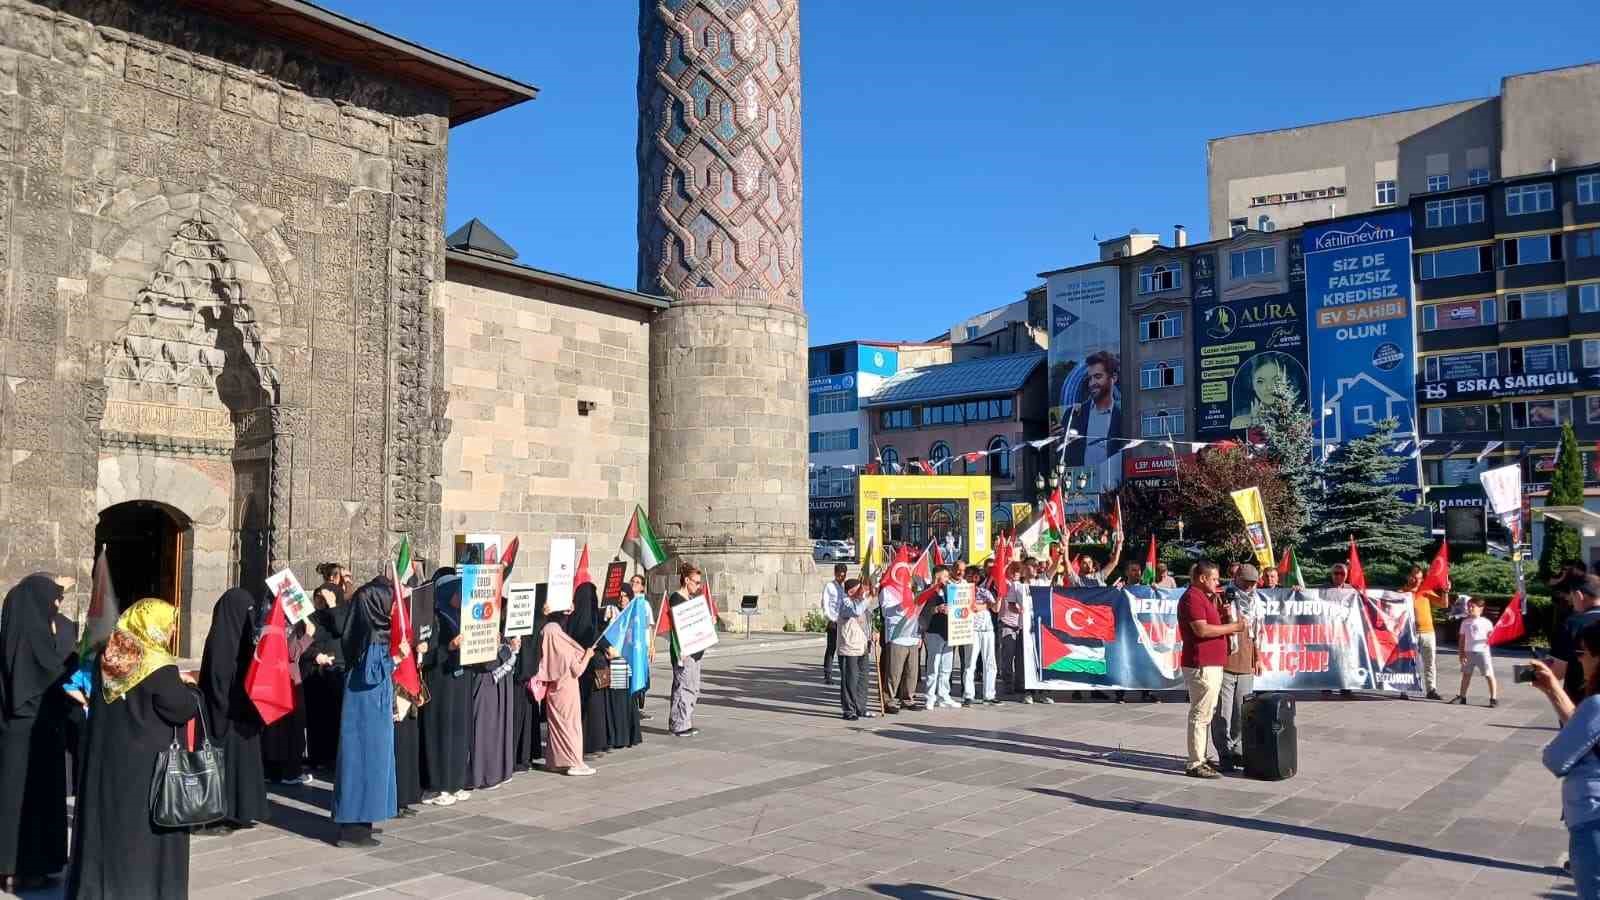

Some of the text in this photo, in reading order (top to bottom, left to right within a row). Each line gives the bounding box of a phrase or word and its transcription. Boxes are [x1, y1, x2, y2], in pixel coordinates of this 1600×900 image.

[1362, 253, 1385, 268] DE
[1241, 302, 1297, 321] AURA
[1321, 310, 1341, 325] EV
[1336, 323, 1387, 341] OLUN!
[1457, 379, 1500, 392] ESRA
[808, 500, 846, 510] OLLECTION
